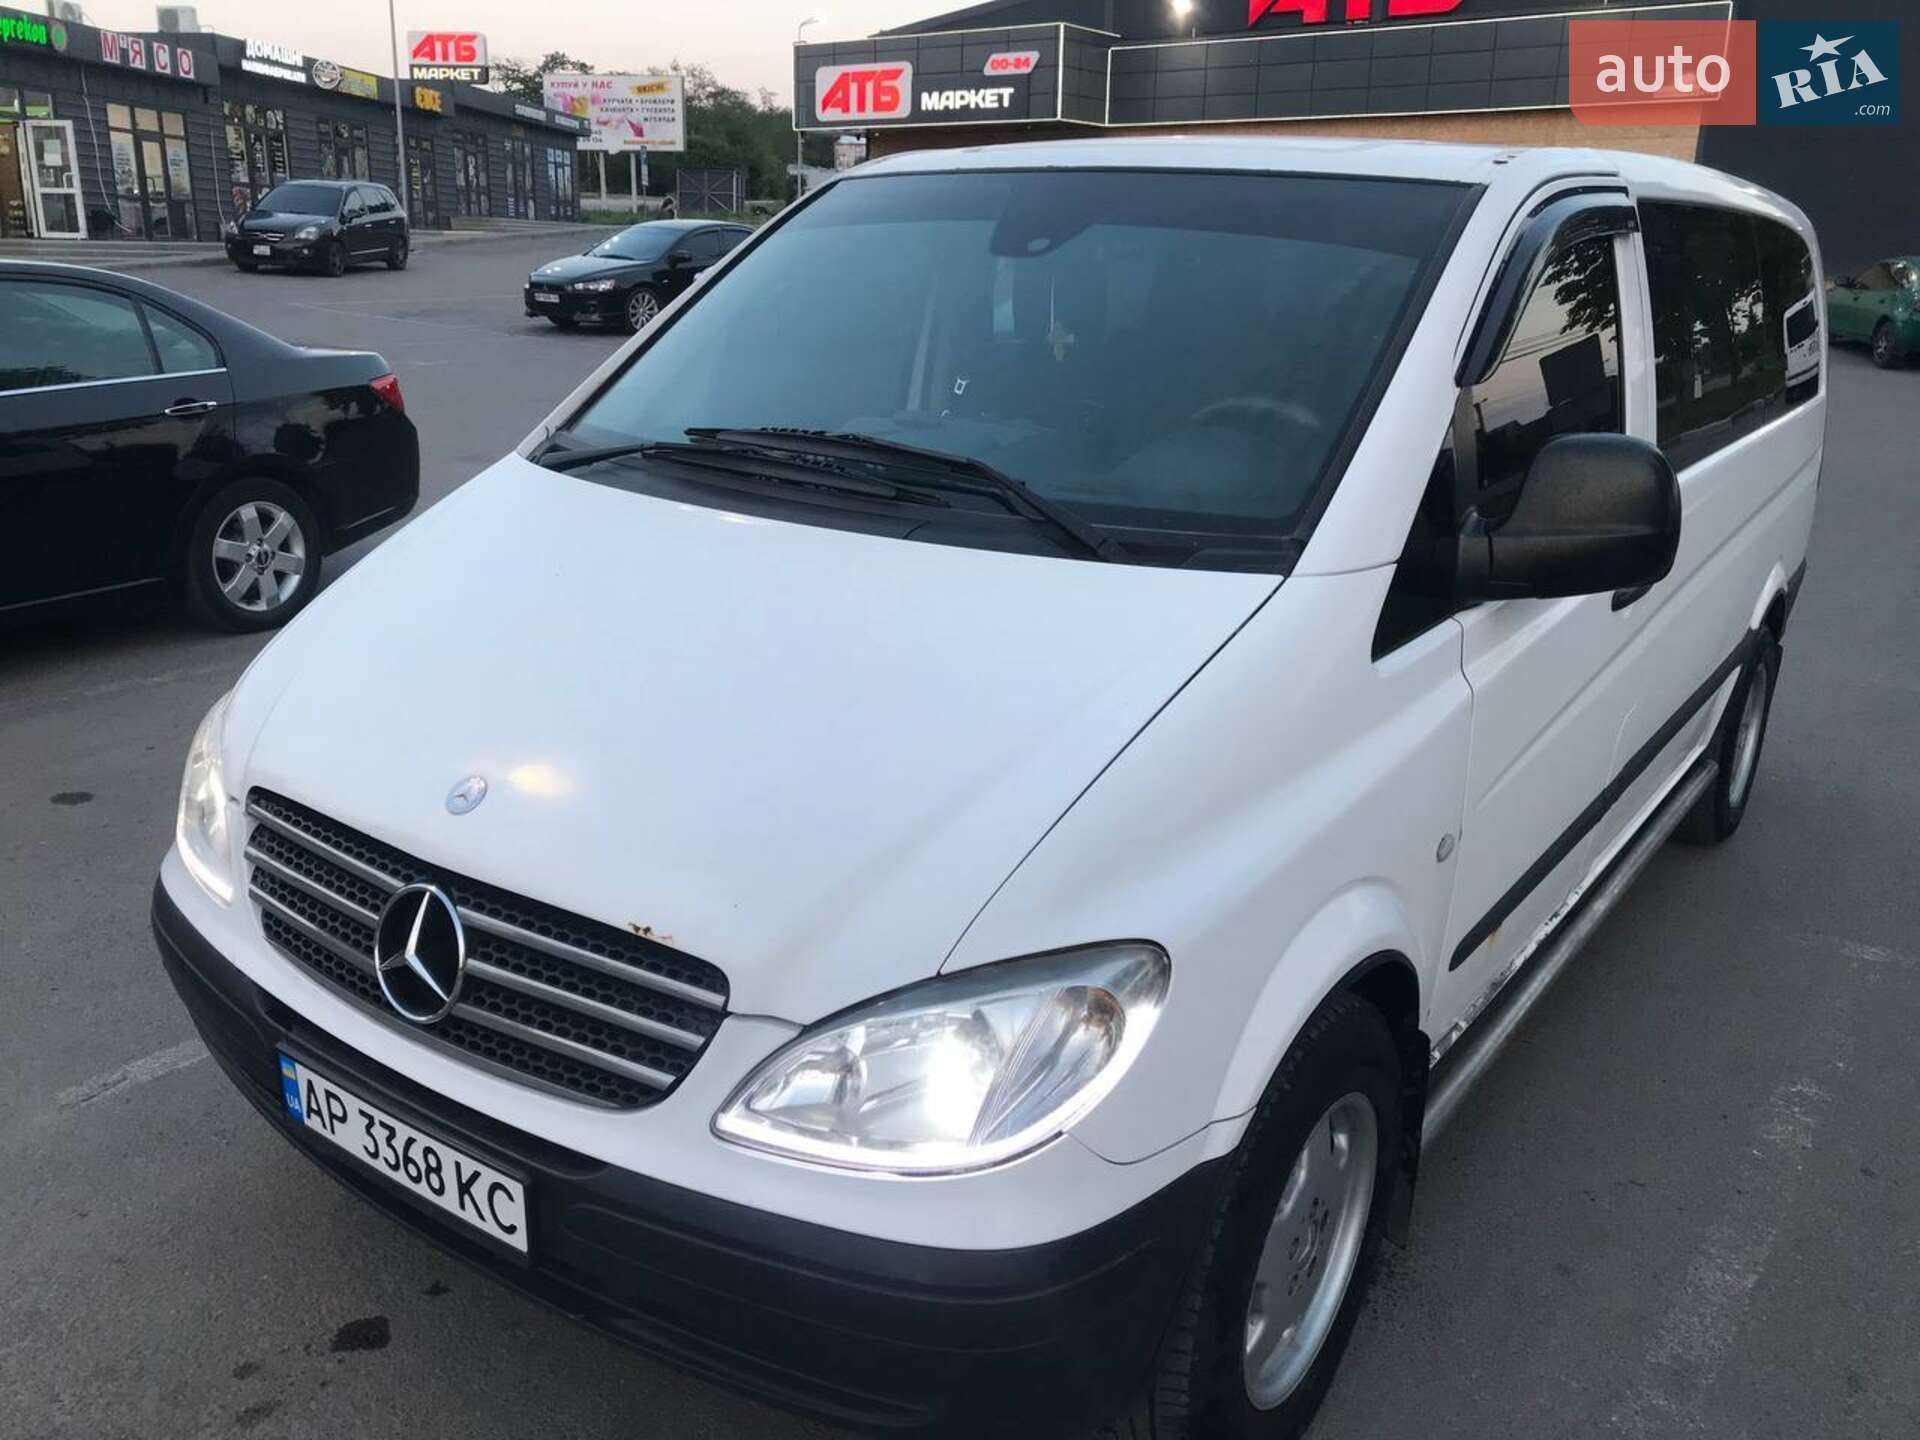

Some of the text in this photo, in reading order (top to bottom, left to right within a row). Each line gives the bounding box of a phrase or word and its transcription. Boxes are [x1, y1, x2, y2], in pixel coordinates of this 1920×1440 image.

[412, 33, 478, 62] АТБ
[412, 66, 482, 80] МАРКЕТ
[990, 57, 1031, 70] 00-24
[591, 80, 613, 89] НАС
[821, 68, 905, 114] АТБ
[920, 87, 1015, 111] МАРКЕТ
[305, 1078, 348, 1135] AP
[358, 1107, 446, 1198] 3368
[454, 1159, 518, 1236] KC
